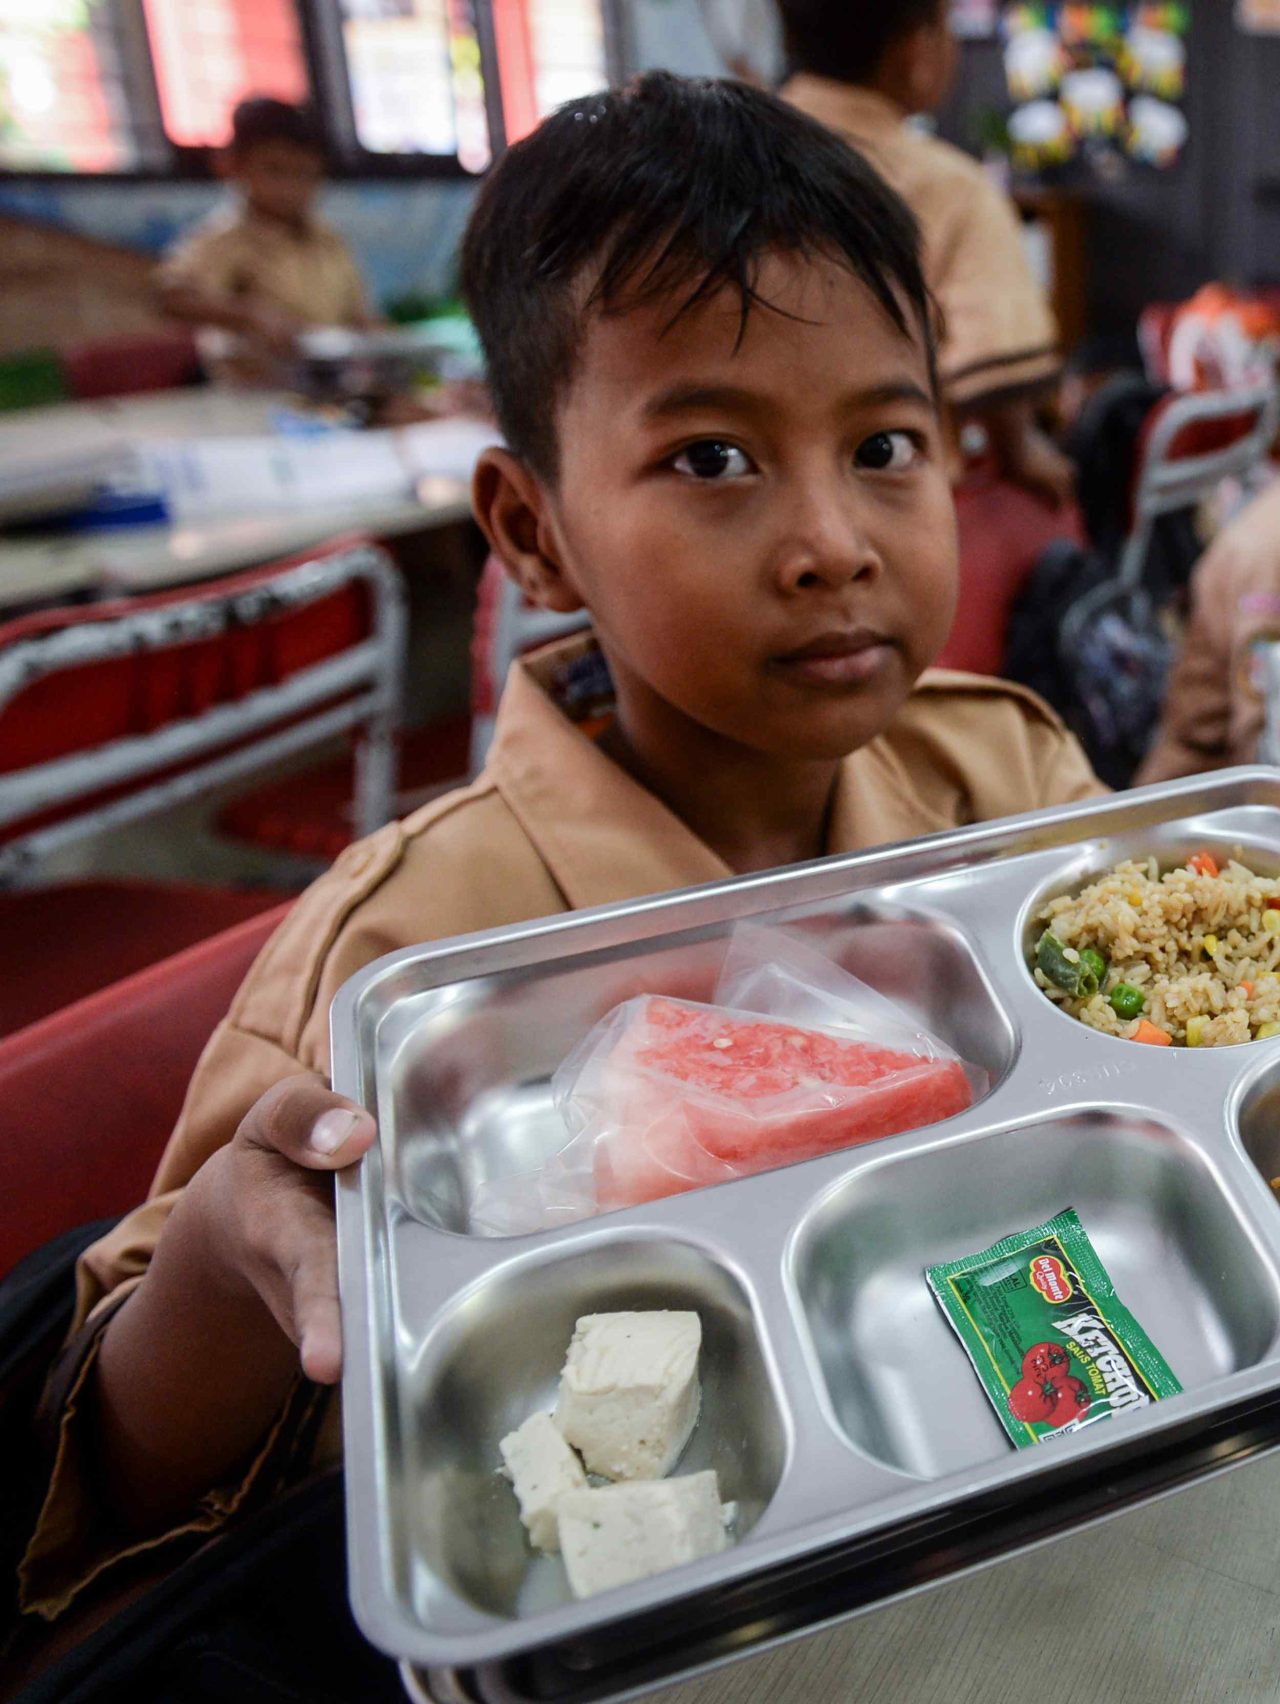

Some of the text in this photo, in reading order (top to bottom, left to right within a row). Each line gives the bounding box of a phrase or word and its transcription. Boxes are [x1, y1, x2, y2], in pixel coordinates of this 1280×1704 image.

[1038, 1258, 1063, 1300] Del Monte
[1066, 1341, 1106, 1395] SAUS TOMAT
